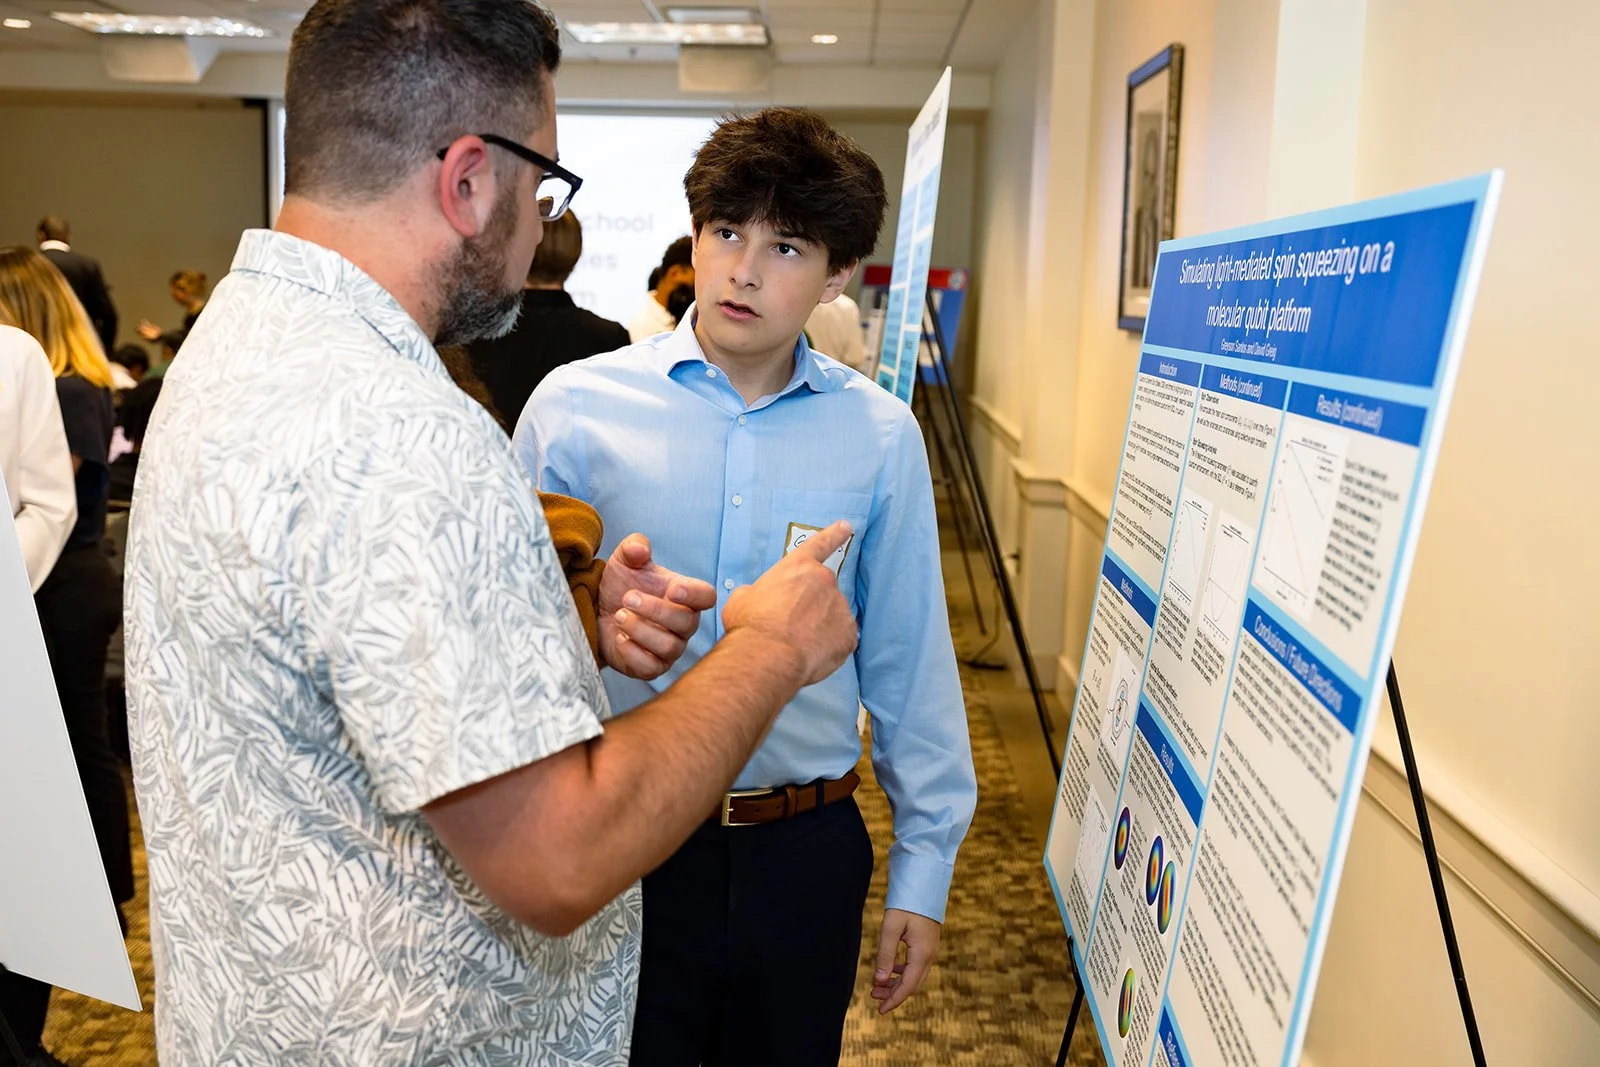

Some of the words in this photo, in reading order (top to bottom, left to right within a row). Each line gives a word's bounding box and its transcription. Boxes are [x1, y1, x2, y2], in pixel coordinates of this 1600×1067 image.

[1180, 257, 1216, 290] Simulating
[1214, 248, 1275, 290] light-mediated
[1273, 246, 1296, 288] spin
[1296, 238, 1360, 286] squeezing
[1359, 242, 1381, 275] on
[1380, 240, 1395, 274] a
[1206, 298, 1246, 329] molecular
[1245, 298, 1270, 337] qubit
[1266, 298, 1312, 338] platform
[1219, 373, 1238, 392] Methods
[1236, 377, 1264, 402] (continued)
[1316, 393, 1343, 419] Results
[1339, 398, 1385, 435] (continued)
[1254, 614, 1288, 659] Conclusions
[1288, 644, 1311, 682] Future
[1307, 662, 1344, 713] Directions
